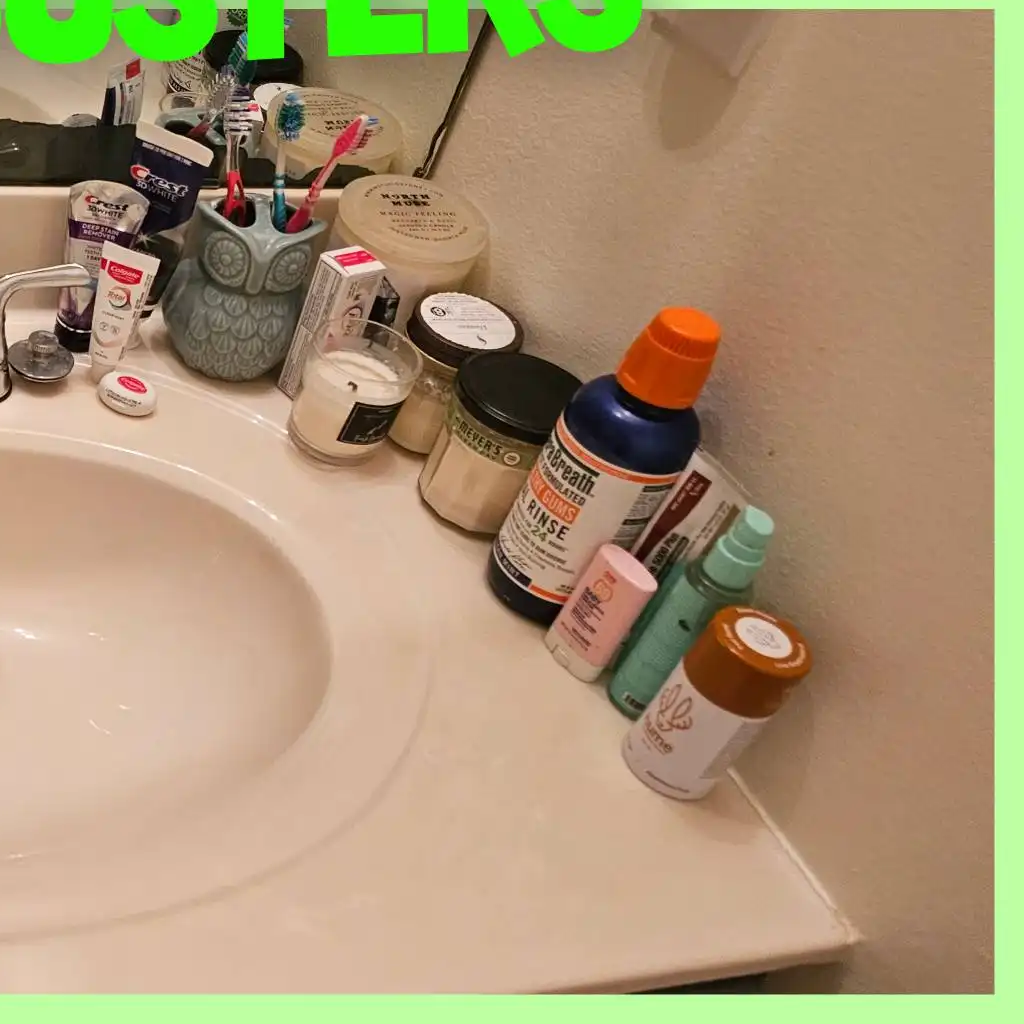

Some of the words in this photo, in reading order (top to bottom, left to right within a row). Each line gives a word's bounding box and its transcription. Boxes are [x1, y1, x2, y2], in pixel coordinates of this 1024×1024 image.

[130, 164, 189, 197] Crest
[85, 195, 128, 212] Crest
[82, 224, 100, 232] DEEP
[100, 226, 120, 236] STAIN
[83, 229, 116, 241] REMOVER
[110, 265, 141, 279] Colgate
[459, 419, 503, 456] MEYER'S
[542, 463, 586, 507] FORMULATED
[542, 489, 576, 522] GUMS
[527, 499, 570, 541] RINSE
[531, 525, 548, 542] 24
